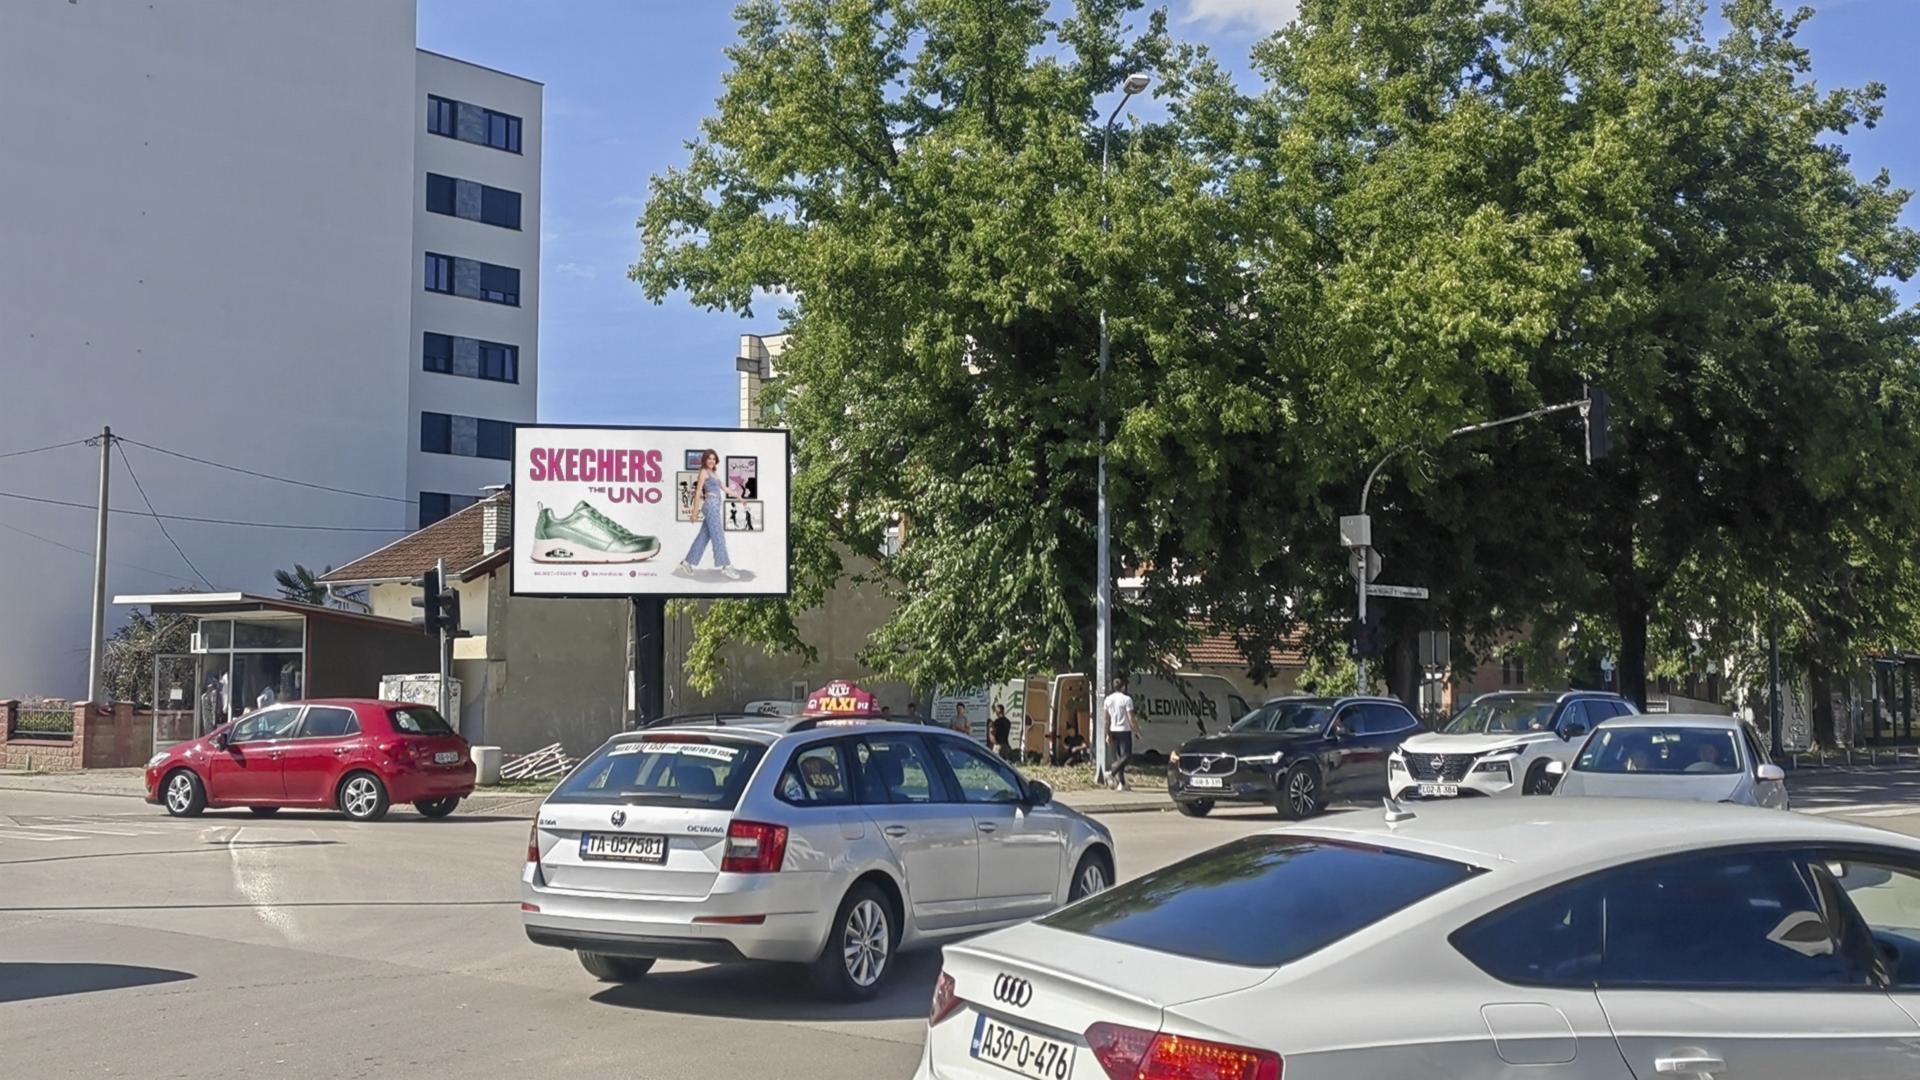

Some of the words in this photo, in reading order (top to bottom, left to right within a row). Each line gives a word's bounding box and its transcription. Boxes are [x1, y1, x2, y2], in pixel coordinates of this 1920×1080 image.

[530, 447, 662, 483] SKECHERS
[608, 487, 662, 503] UNO
[819, 697, 857, 712] TAXI
[1147, 699, 1217, 716] LEDWINNER
[589, 836, 662, 855] TA-057581
